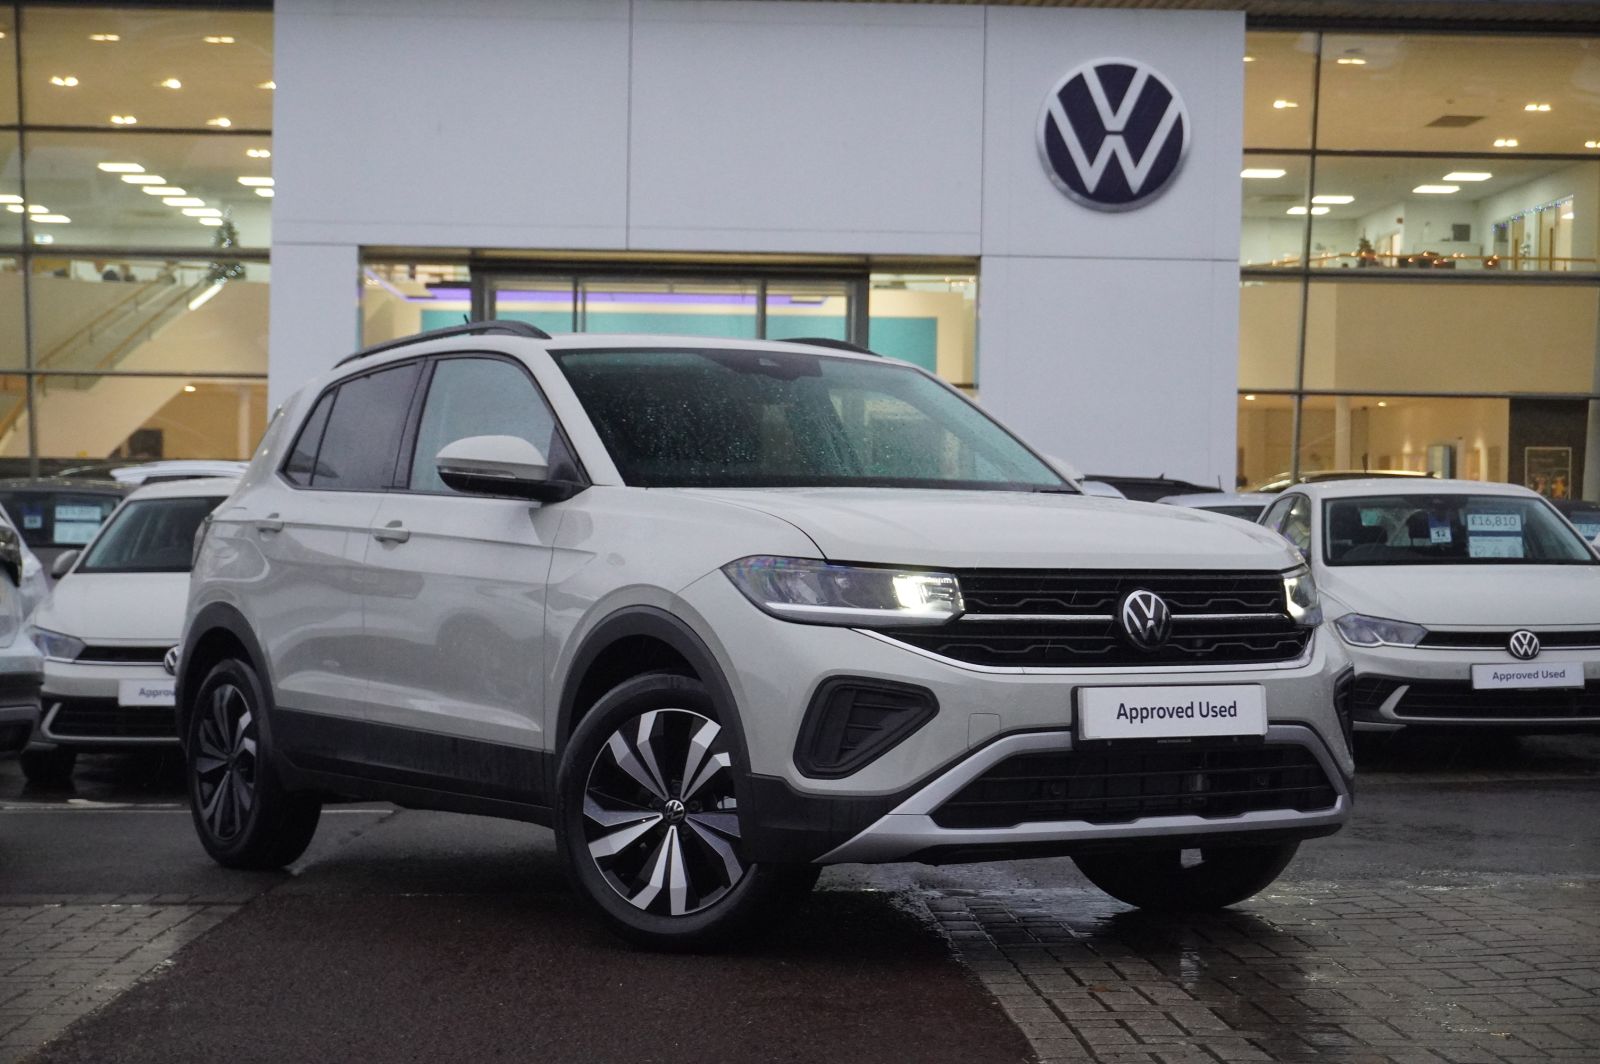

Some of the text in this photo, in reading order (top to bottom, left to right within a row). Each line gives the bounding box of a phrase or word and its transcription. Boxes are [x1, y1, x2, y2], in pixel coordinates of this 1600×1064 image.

[1492, 669, 1566, 682] Approved Used
[1116, 700, 1238, 724] Approved Used
